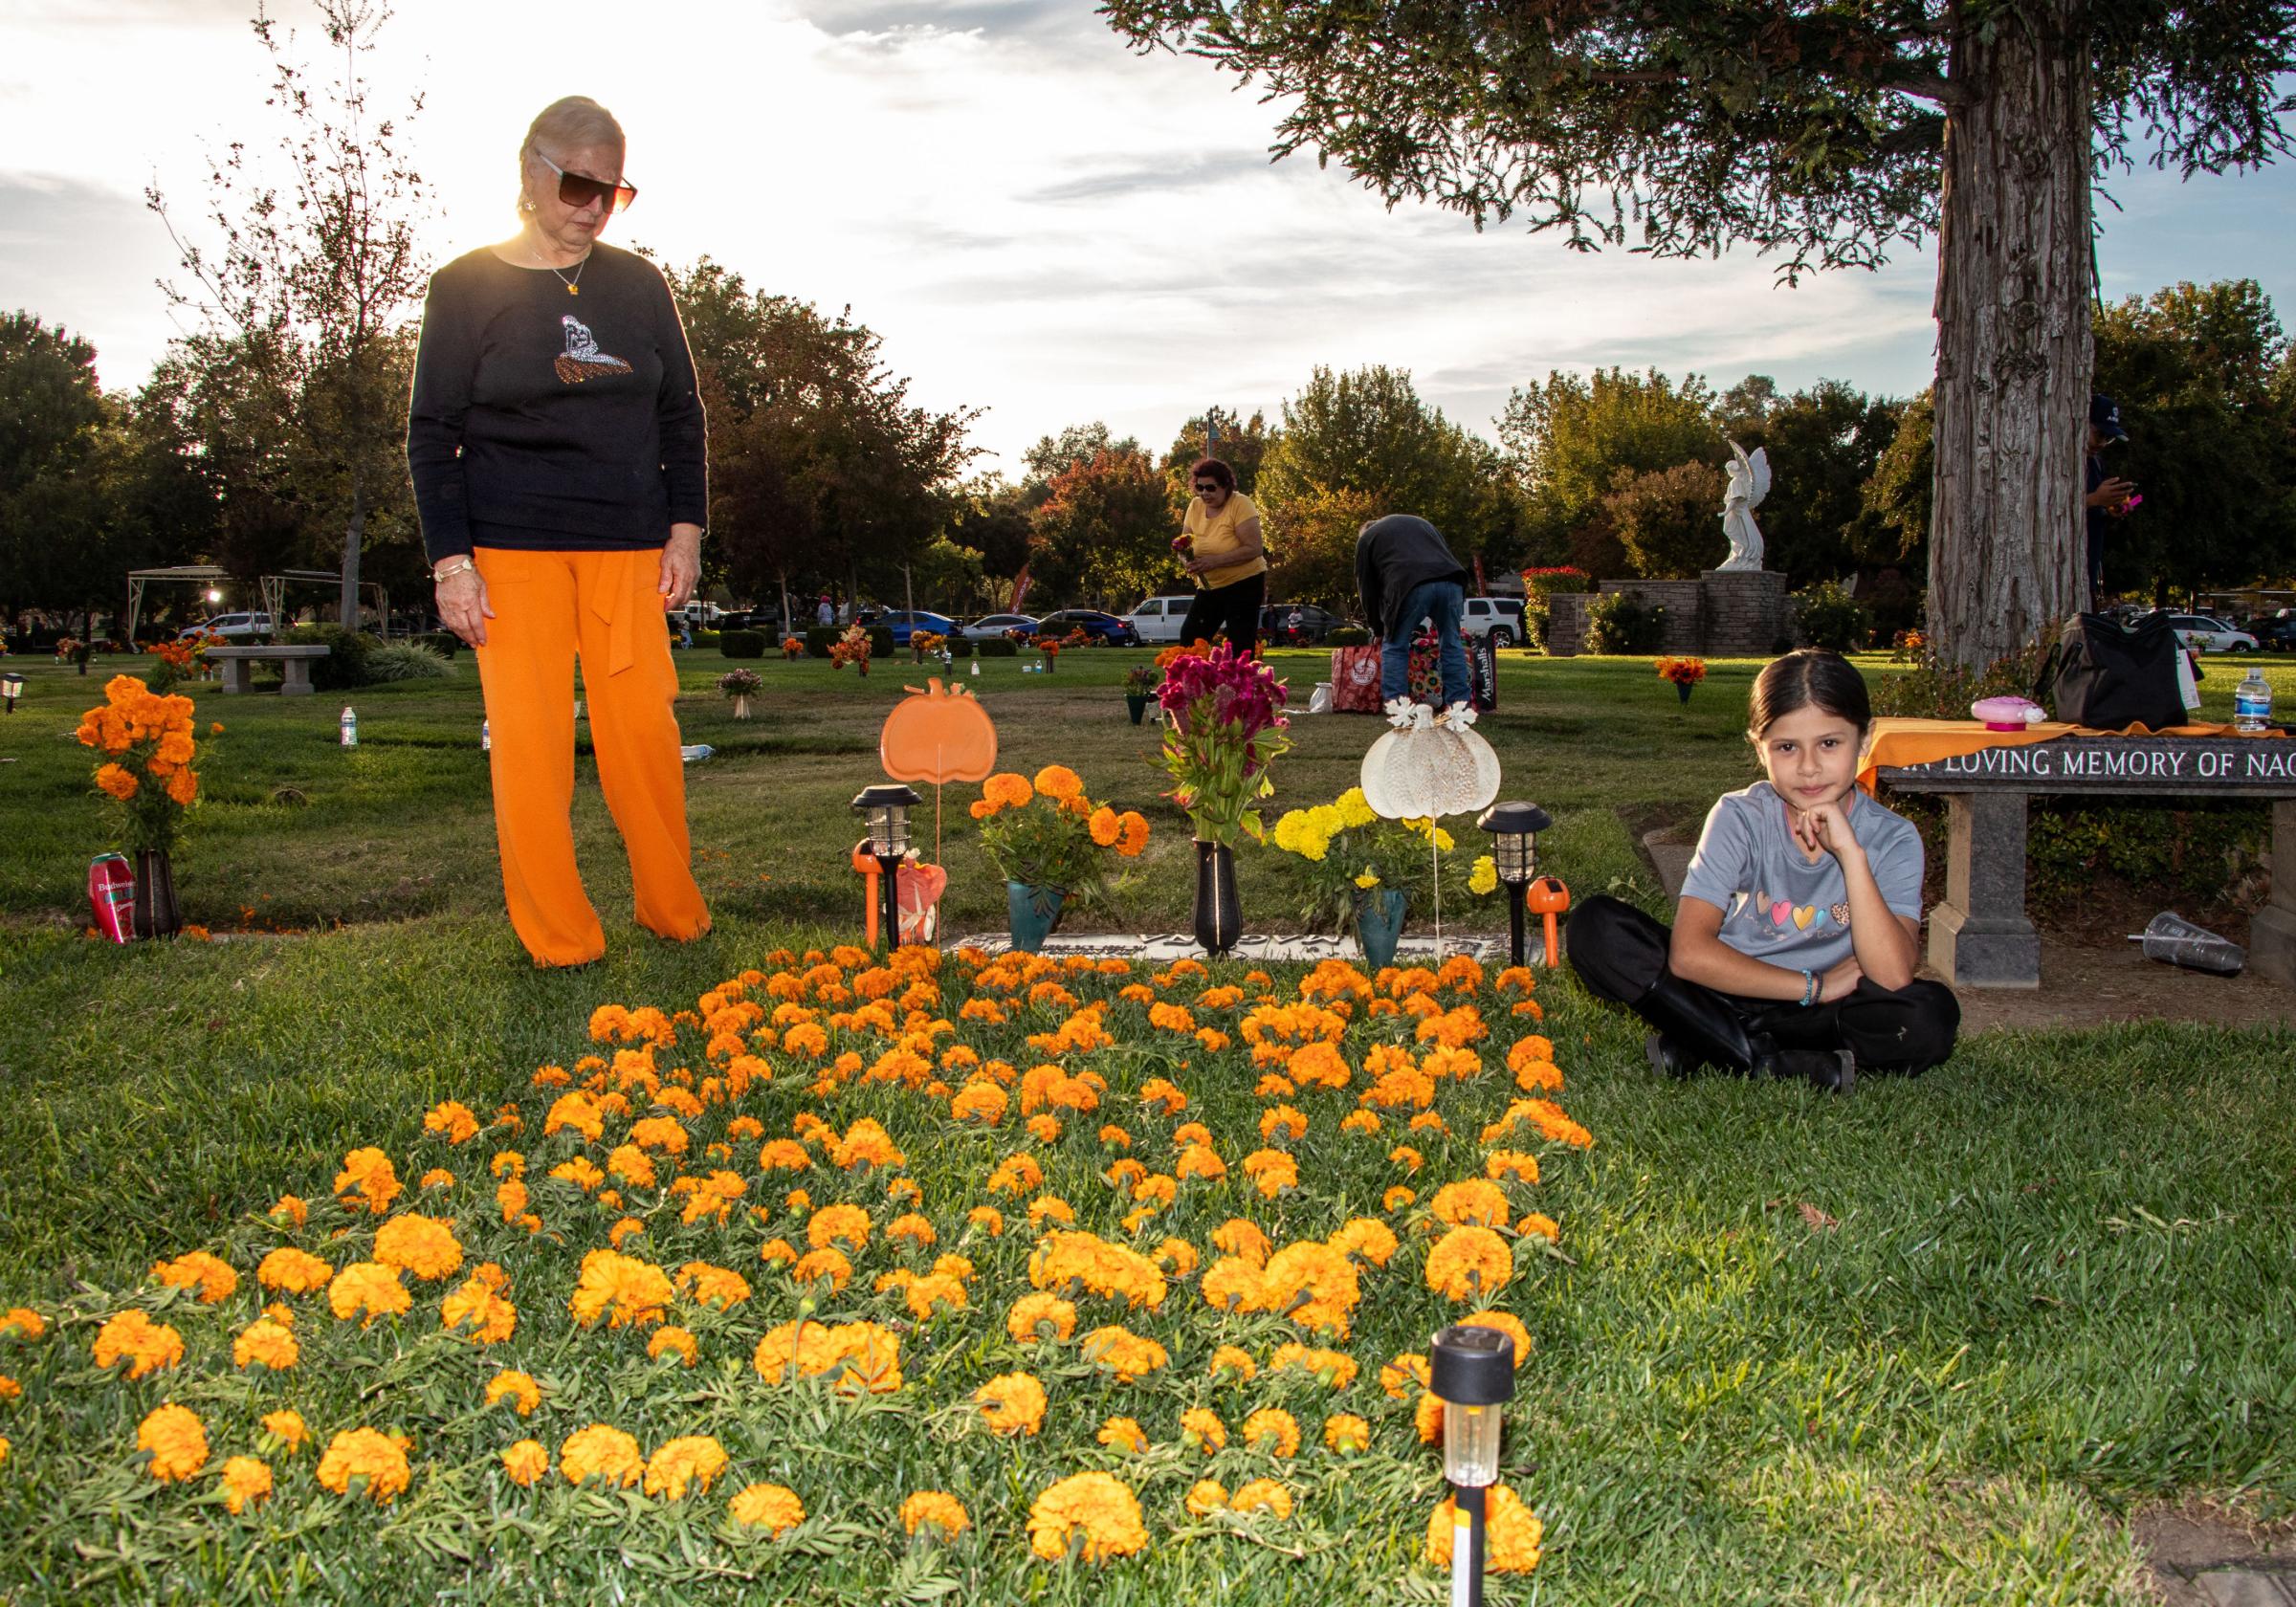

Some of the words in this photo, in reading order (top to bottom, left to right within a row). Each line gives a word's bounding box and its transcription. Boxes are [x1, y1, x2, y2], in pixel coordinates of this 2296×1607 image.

[1477, 648, 1490, 701] Marshalls
[1945, 749, 2050, 775] LOVING
[2064, 750, 2186, 777] MEMORY
[2198, 752, 2235, 777] OF
